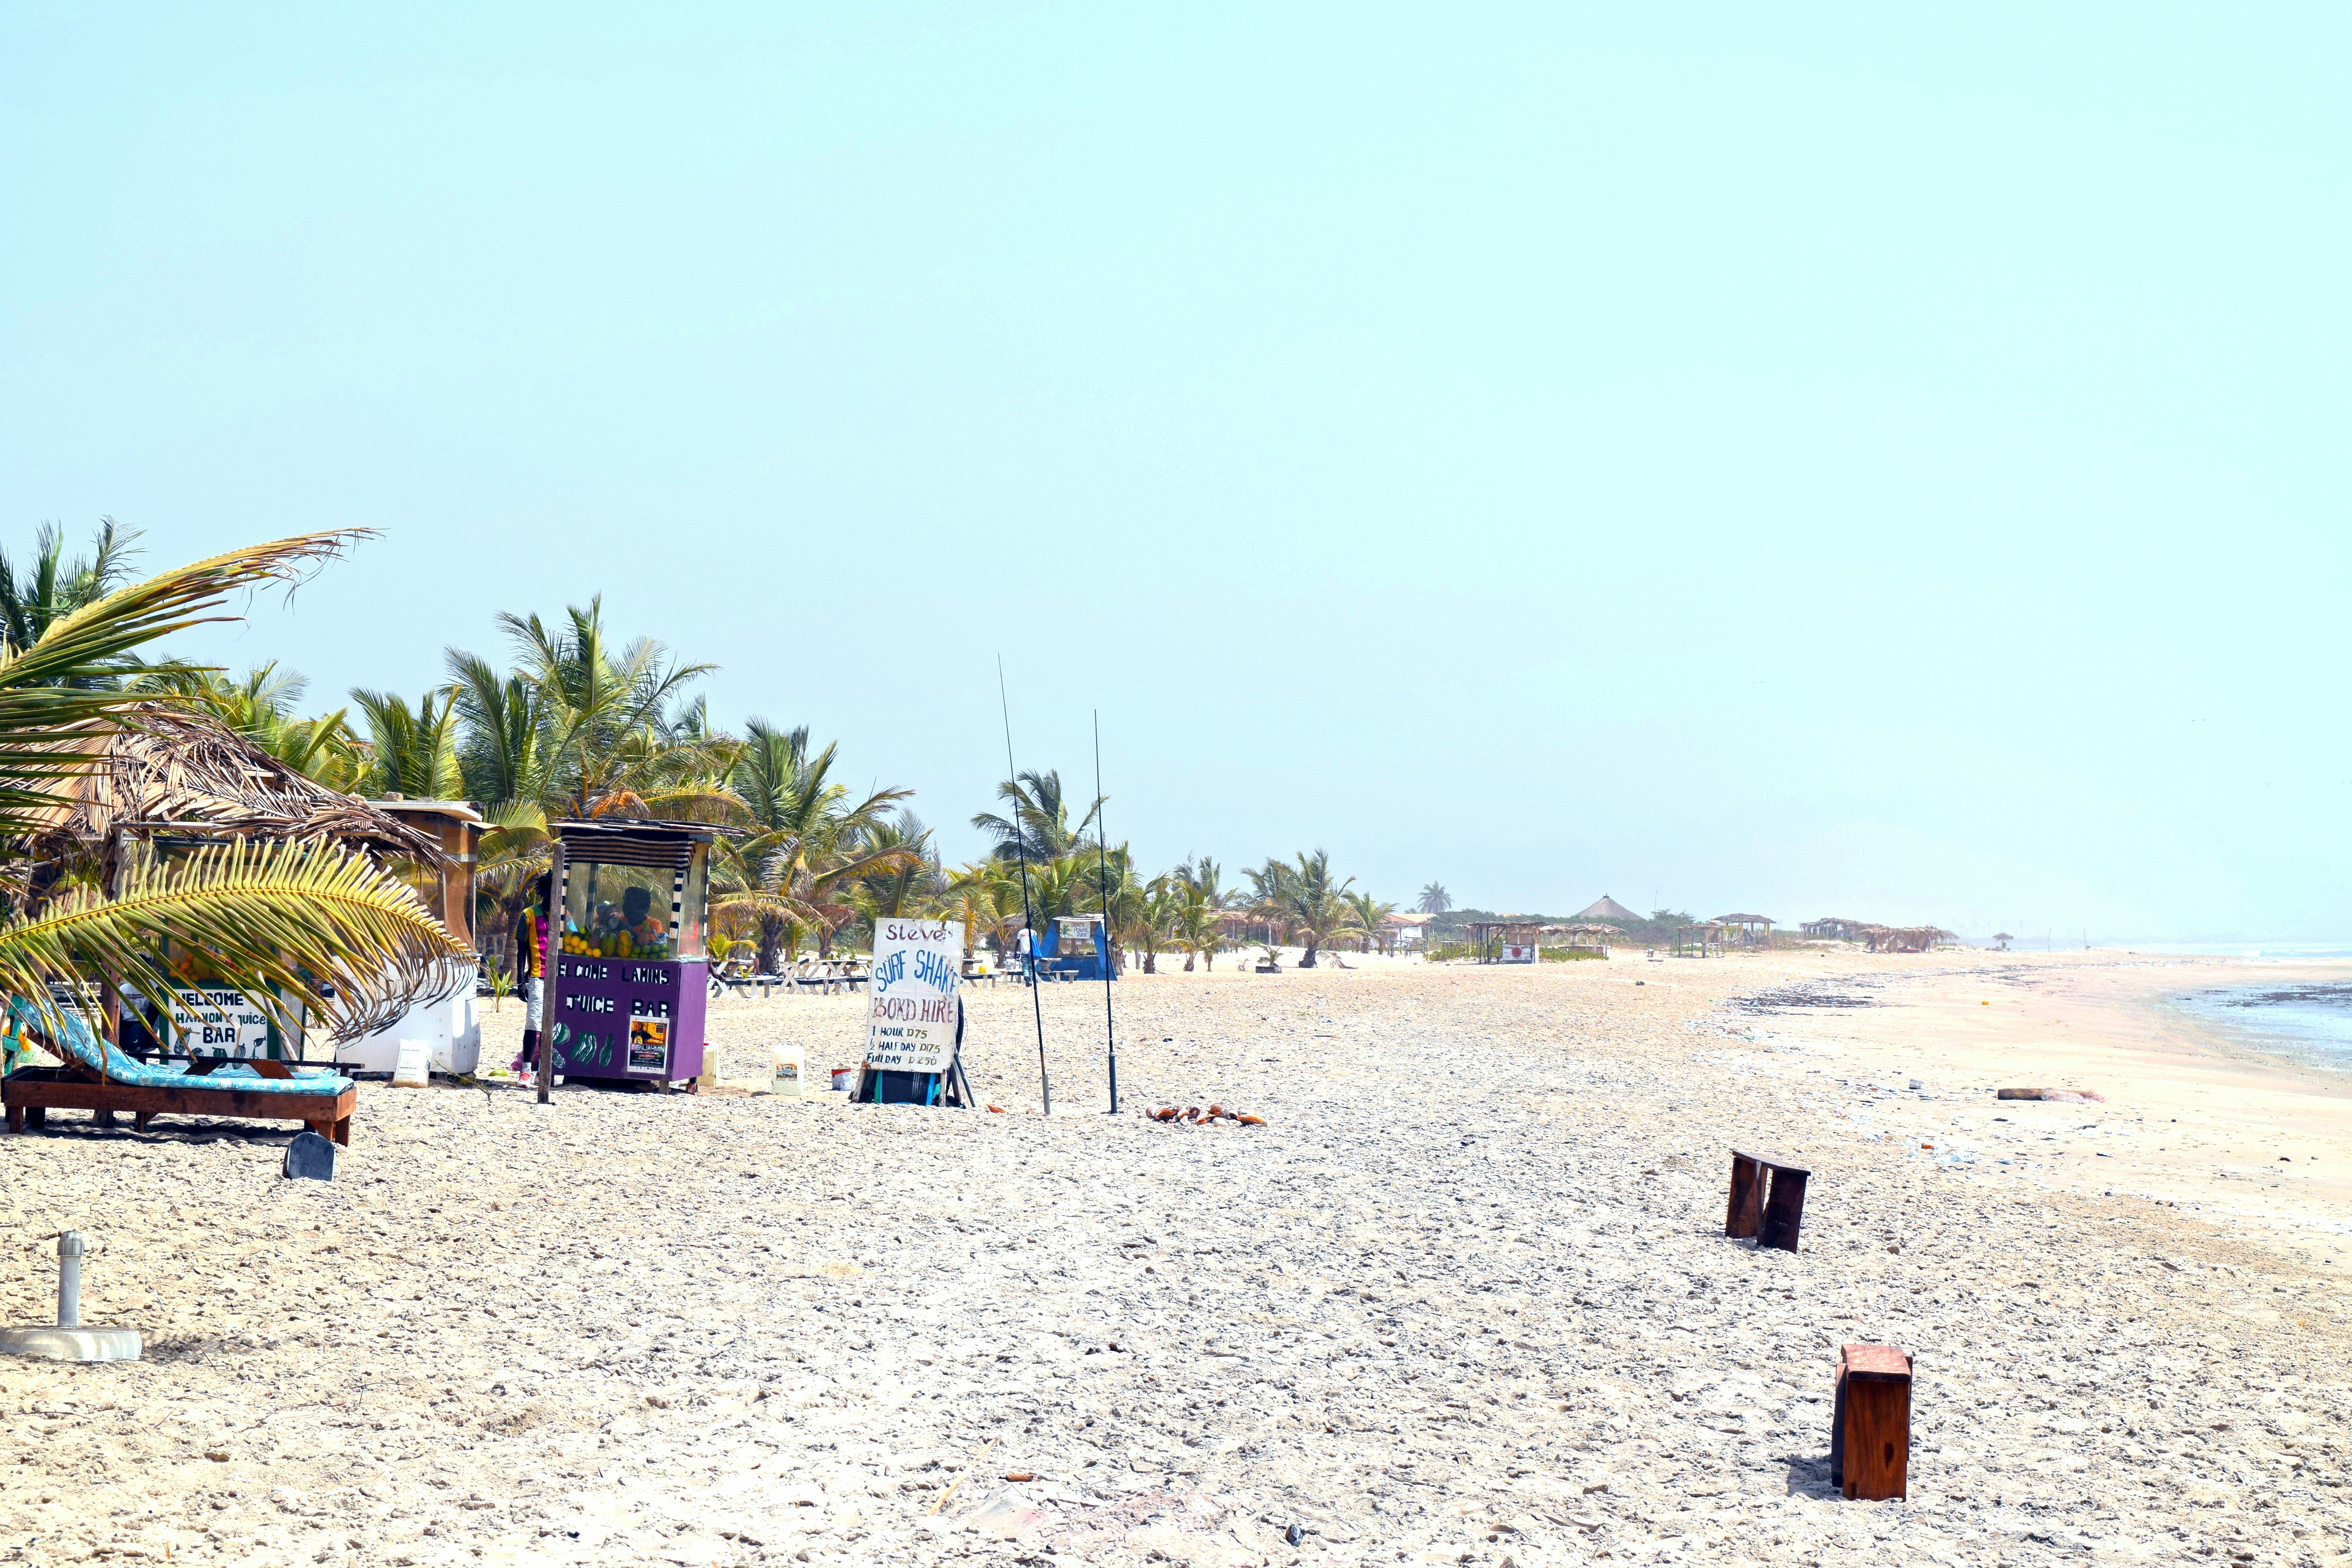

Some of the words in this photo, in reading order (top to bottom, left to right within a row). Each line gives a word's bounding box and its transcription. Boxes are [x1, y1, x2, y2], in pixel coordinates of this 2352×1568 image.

[556, 962, 607, 979] ELCOME
[621, 967, 670, 985] LAMINS
[875, 950, 906, 992] SURF
[566, 994, 614, 1014] JUICE
[631, 998, 670, 1018] BAR
[203, 1026, 235, 1043] BAR
[881, 1027, 904, 1037] HOUR
[878, 1041, 900, 1051] HALF
[900, 1042, 916, 1052] DAY
[885, 1055, 902, 1065] DAY
